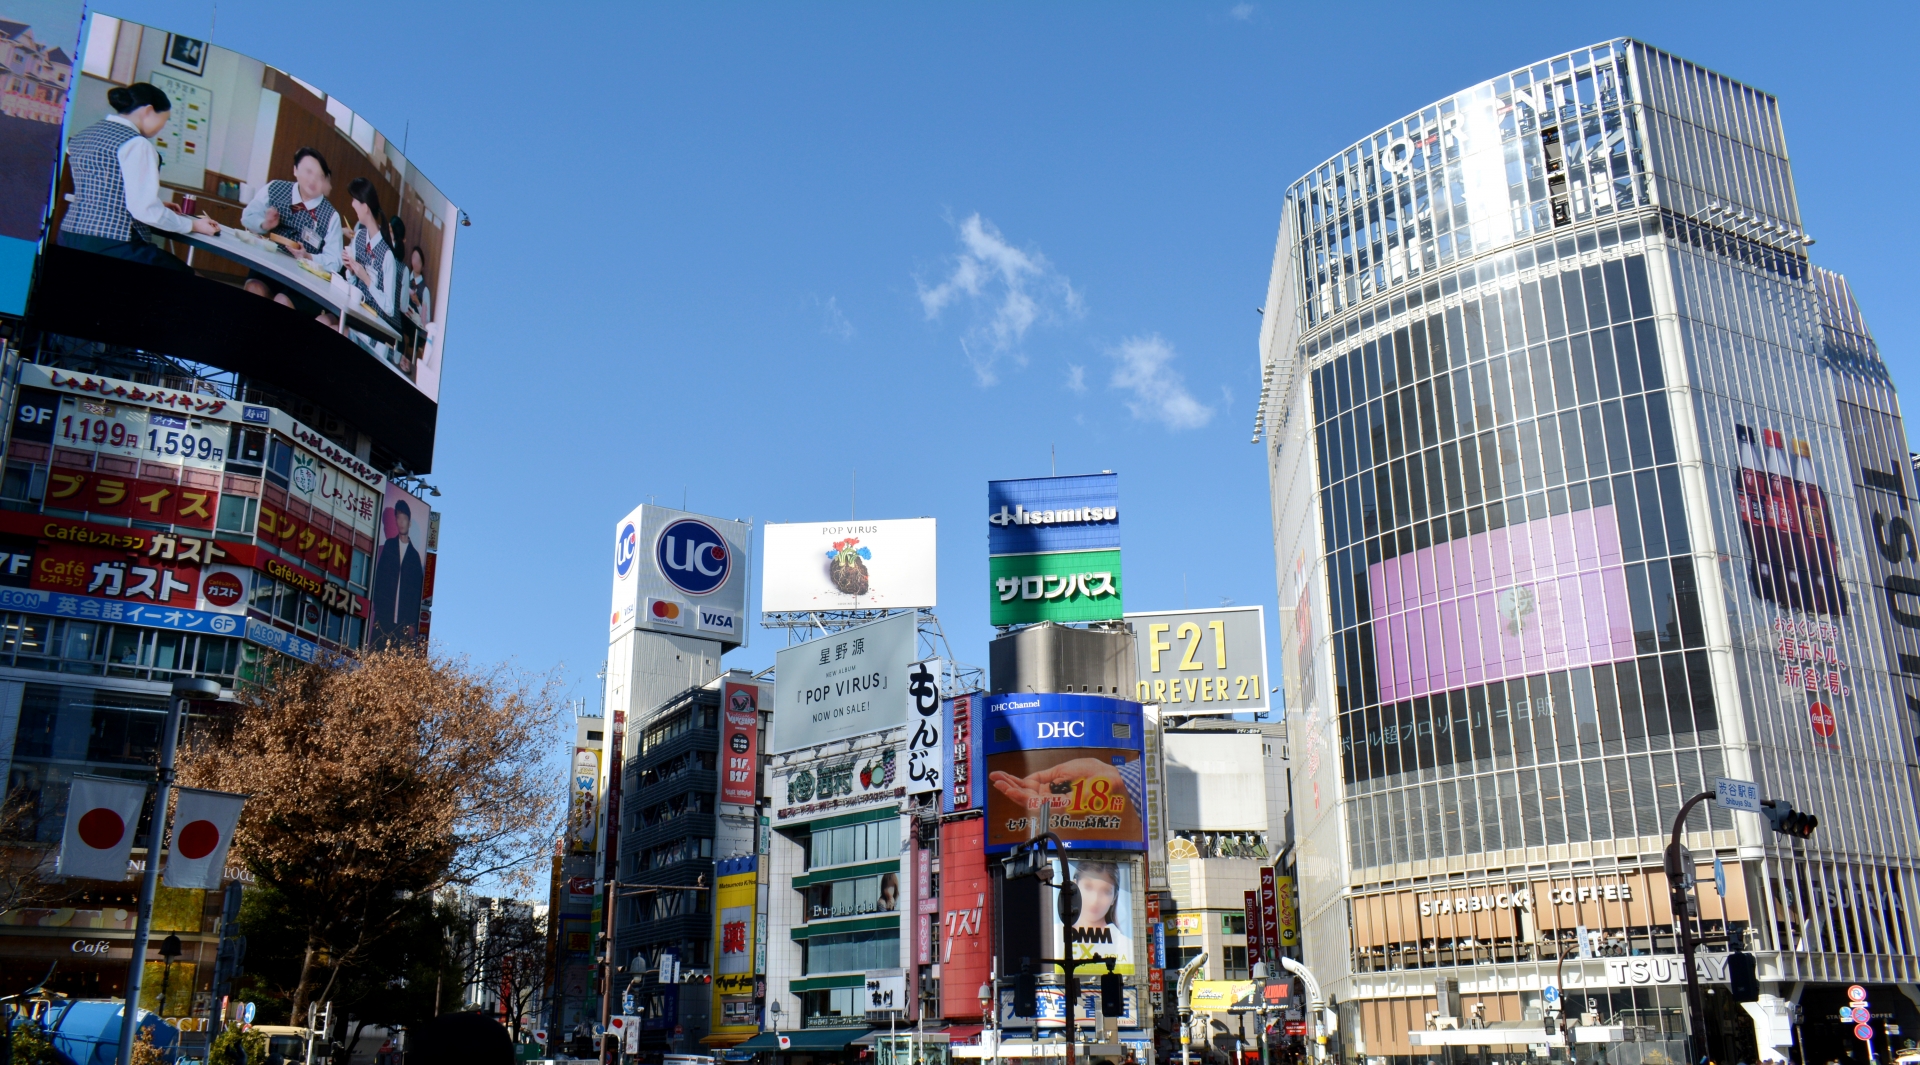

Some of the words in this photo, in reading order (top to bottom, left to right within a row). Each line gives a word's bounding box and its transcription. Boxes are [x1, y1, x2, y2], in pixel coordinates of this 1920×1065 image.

[51, 370, 227, 414] しゃぶしゃぶバイキング
[20, 405, 53, 424] 9F
[153, 415, 184, 427] ディナー
[244, 408, 267, 421] 寿司
[62, 415, 138, 448] 1,199円
[148, 428, 223, 462] 1,599円
[292, 422, 384, 486] しゃぶしゃぶバイキング
[52, 474, 212, 518] プライス
[320, 473, 374, 521] しゃぶ葉
[990, 504, 1116, 526] Hisamitsu
[258, 506, 348, 568] コンタクト
[822, 526, 844, 535] POP
[847, 526, 878, 534] VIRUS
[148, 533, 226, 564] ガスト
[618, 532, 635, 566] UC
[666, 536, 722, 576] UC
[40, 558, 86, 577] Café
[40, 575, 82, 587] レストラン
[88, 561, 189, 600] ガスト
[996, 572, 1116, 601] サロンパス
[0, 590, 40, 606] EON
[208, 586, 239, 598] ガスト
[322, 582, 362, 614] ガスト
[624, 604, 634, 616] VISA
[700, 612, 733, 628] VISA
[213, 618, 233, 630] 6F
[254, 624, 282, 646] AEON
[1774, 617, 1838, 640] おみくじ付き
[818, 638, 865, 666] 星野源
[1148, 620, 1228, 673] F21
[826, 670, 837, 678] NEW
[838, 665, 856, 675] ALBUM
[1136, 676, 1230, 703] OREVER
[1236, 674, 1260, 700] 21
[812, 711, 830, 723] NOW
[834, 708, 844, 718] ON
[846, 701, 870, 715] SALE!
[991, 704, 1008, 712] DHC
[1008, 700, 1040, 710] Channel
[909, 663, 939, 788] もんじゃ
[1038, 720, 1084, 739] DHC
[954, 698, 968, 804] 三千里薬品
[1145, 724, 1160, 785] Taisei
[731, 757, 749, 769] B1F
[730, 771, 749, 782] B2F
[1718, 782, 1756, 800] 渋谷駅前
[1726, 797, 1743, 807] Shibuya
[1744, 800, 1753, 808] Sta.
[1006, 814, 1121, 832] セサ36mg高配合
[1148, 790, 1160, 840] neon
[920, 852, 928, 896] お好み焼
[718, 881, 743, 890] Matsumoto
[813, 903, 874, 916] Euphoria
[1262, 875, 1276, 930] カラオケ
[1420, 888, 1535, 916] STARBUCKS
[1548, 884, 1632, 904] COFFEE
[1813, 886, 1904, 912] TSUTAYA
[723, 920, 746, 954] 薬
[1283, 930, 1293, 938] 4F
[72, 940, 110, 956] Café
[1150, 972, 1161, 990] 焼肉
[1610, 956, 1729, 984] TSUTAY
